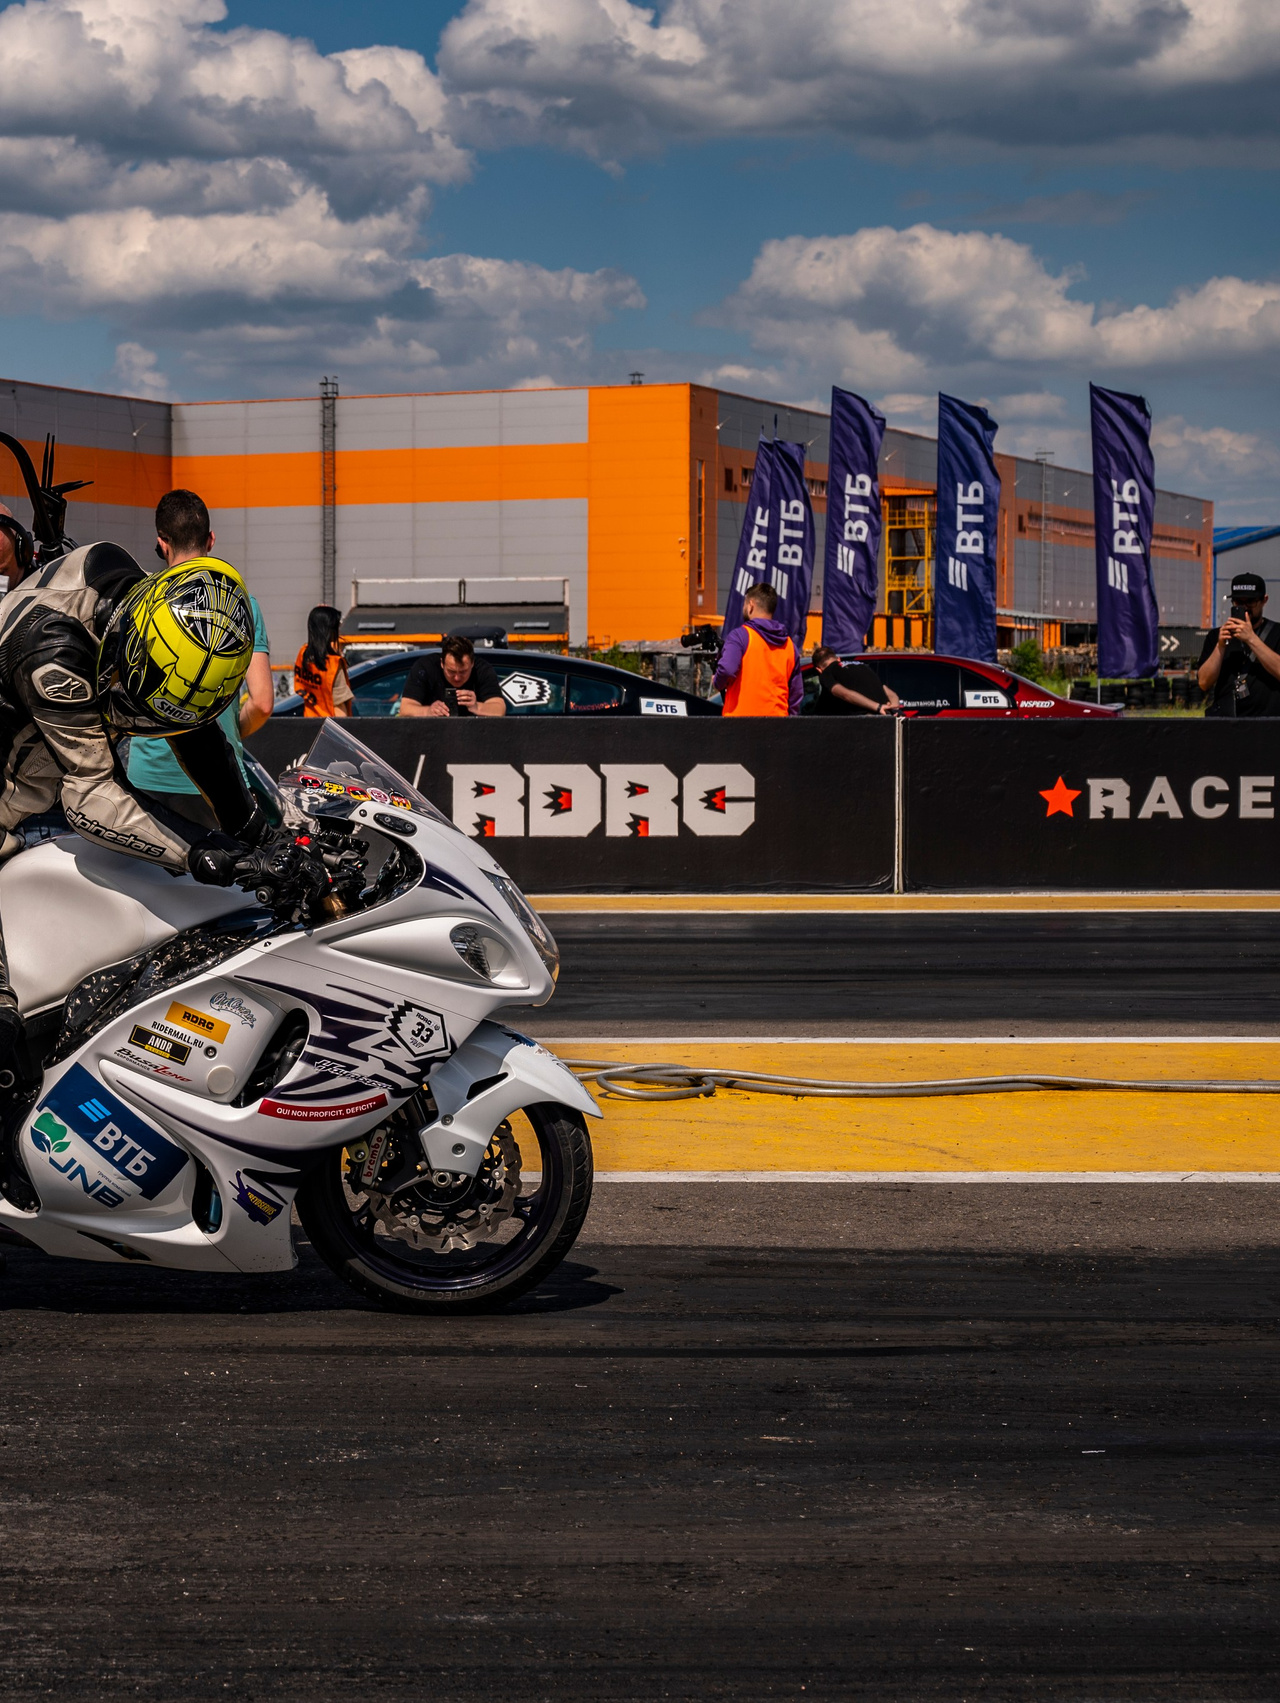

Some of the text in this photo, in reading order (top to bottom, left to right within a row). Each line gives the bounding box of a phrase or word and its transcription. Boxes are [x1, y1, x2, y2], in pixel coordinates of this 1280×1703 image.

[844, 473, 872, 542] ВТБ
[956, 480, 984, 554] ВТБ
[1111, 478, 1145, 554] ВТБ
[778, 499, 805, 567] ВТБ
[519, 684, 527, 694] 7
[981, 695, 1000, 704] ВТБ
[655, 703, 678, 714] ВТБ
[447, 763, 756, 837] RDRC
[1087, 775, 1276, 819] RACE
[66, 808, 165, 857] alpinestars
[151, 1020, 204, 1049] RIDERMALL.RU
[181, 1011, 214, 1031] RDRC
[411, 1021, 434, 1043] 33
[147, 1034, 173, 1053] ANDR
[114, 1051, 151, 1071] PERFORMANCE
[276, 1107, 290, 1116] QUI
[291, 1110, 308, 1118] NON
[308, 1110, 344, 1118] PROFICIT,
[92, 1121, 157, 1177] ВТБ
[363, 1136, 383, 1178] brembo
[437, 1281, 498, 1299] ROADTEC
